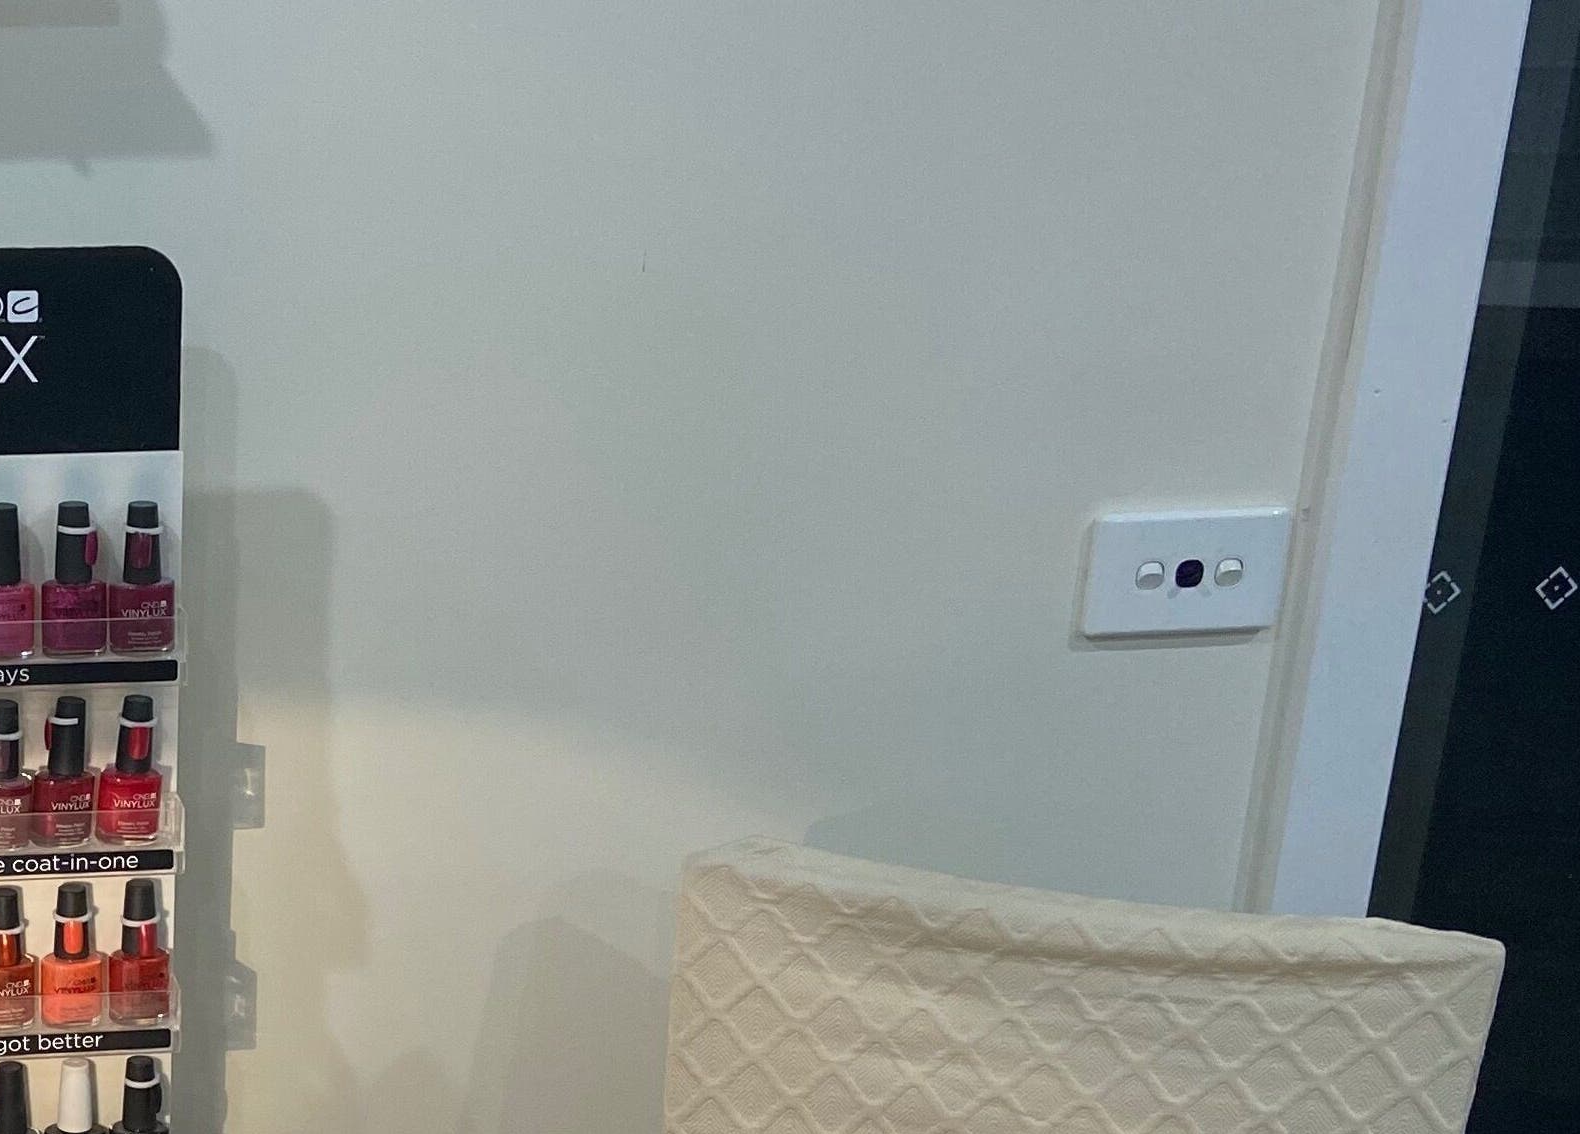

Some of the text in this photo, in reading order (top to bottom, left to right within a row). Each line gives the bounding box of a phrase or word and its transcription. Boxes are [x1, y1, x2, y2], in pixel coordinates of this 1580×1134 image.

[121, 608, 168, 618] VINYLUX
[51, 801, 91, 811] VINYLUX
[113, 799, 155, 809] VINYLUX
[12, 853, 139, 873] coat-in-one
[37, 1033, 104, 1051] better
